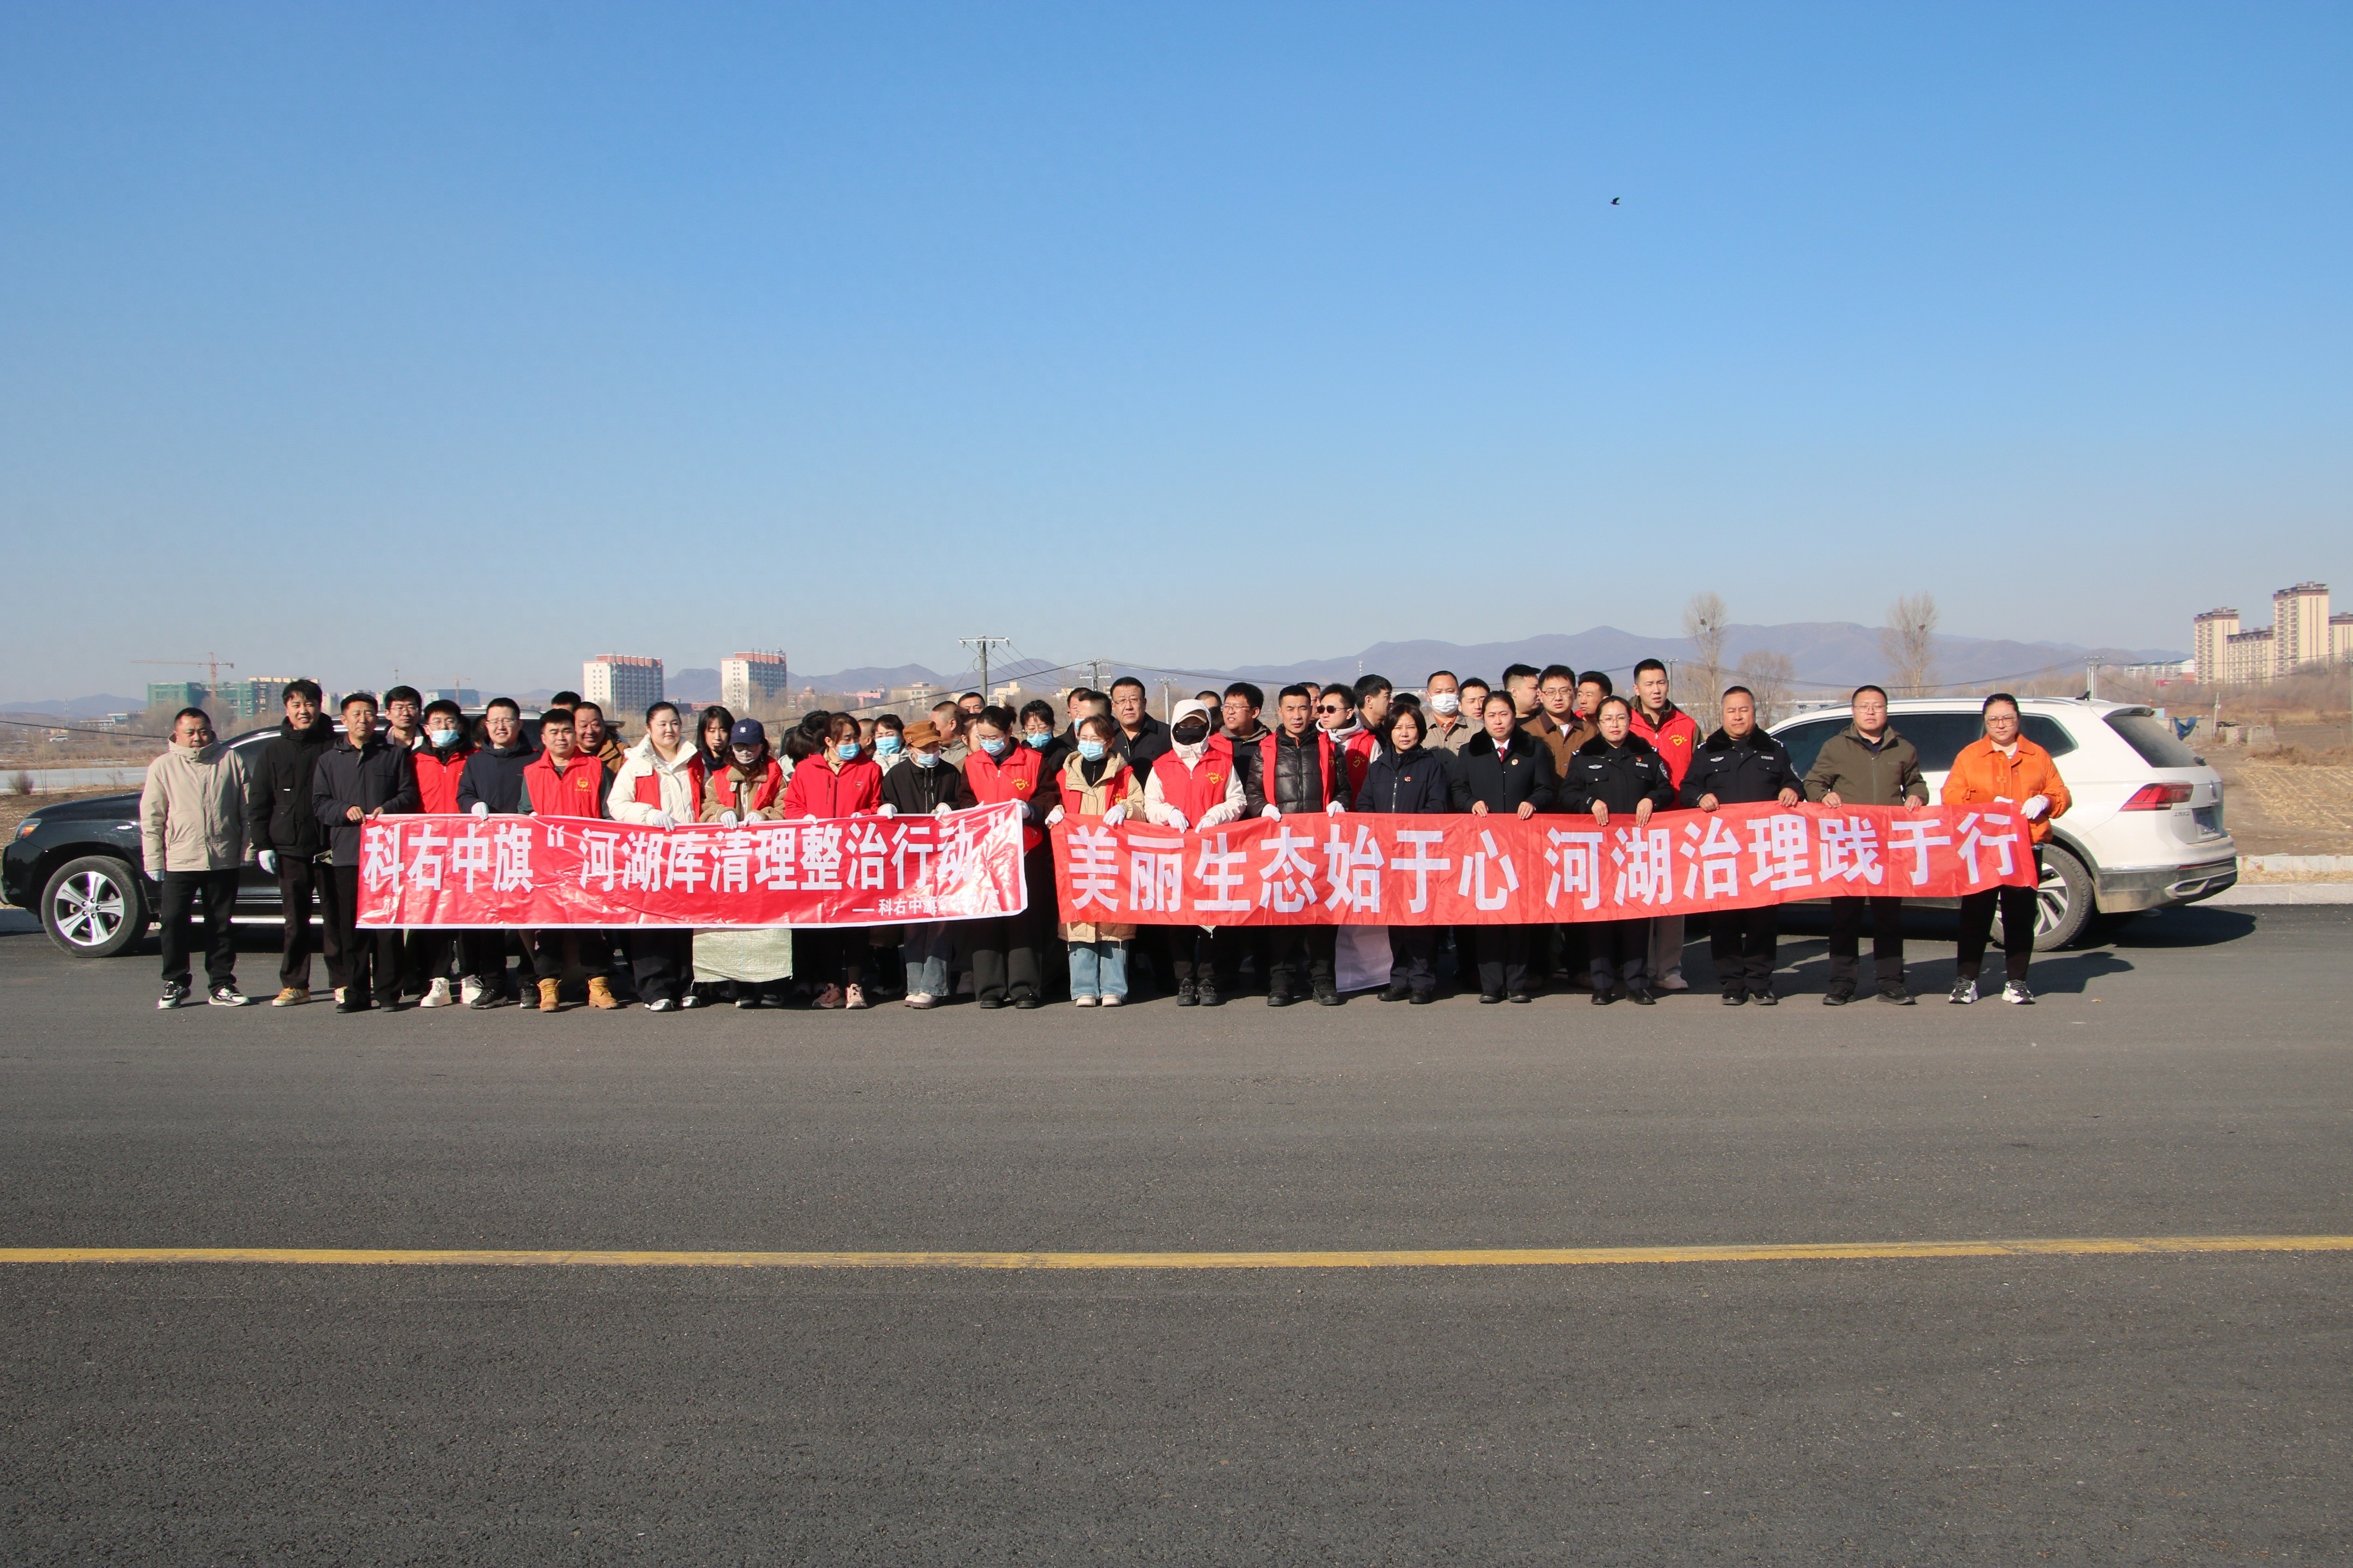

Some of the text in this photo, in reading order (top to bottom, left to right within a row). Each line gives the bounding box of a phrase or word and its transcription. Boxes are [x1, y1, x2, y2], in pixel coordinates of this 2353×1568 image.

[1067, 812, 2018, 914] 美丽生态始于心 河湖治理践于行
